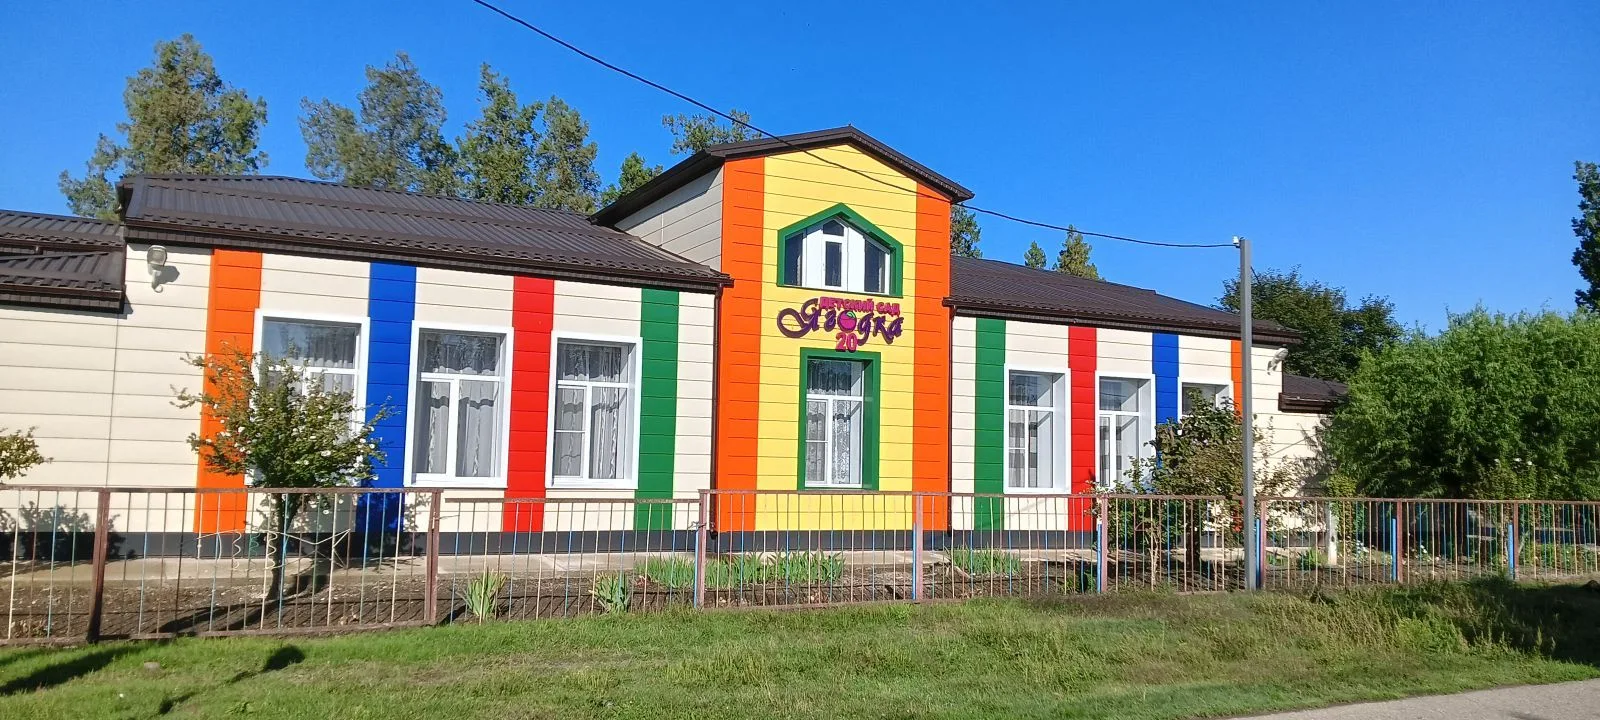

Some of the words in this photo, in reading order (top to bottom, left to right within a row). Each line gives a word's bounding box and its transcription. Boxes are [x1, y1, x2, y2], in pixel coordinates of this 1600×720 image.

[819, 296, 874, 313] ДЕТСКИЙ
[876, 302, 900, 317] САД
[835, 332, 858, 353] 20
